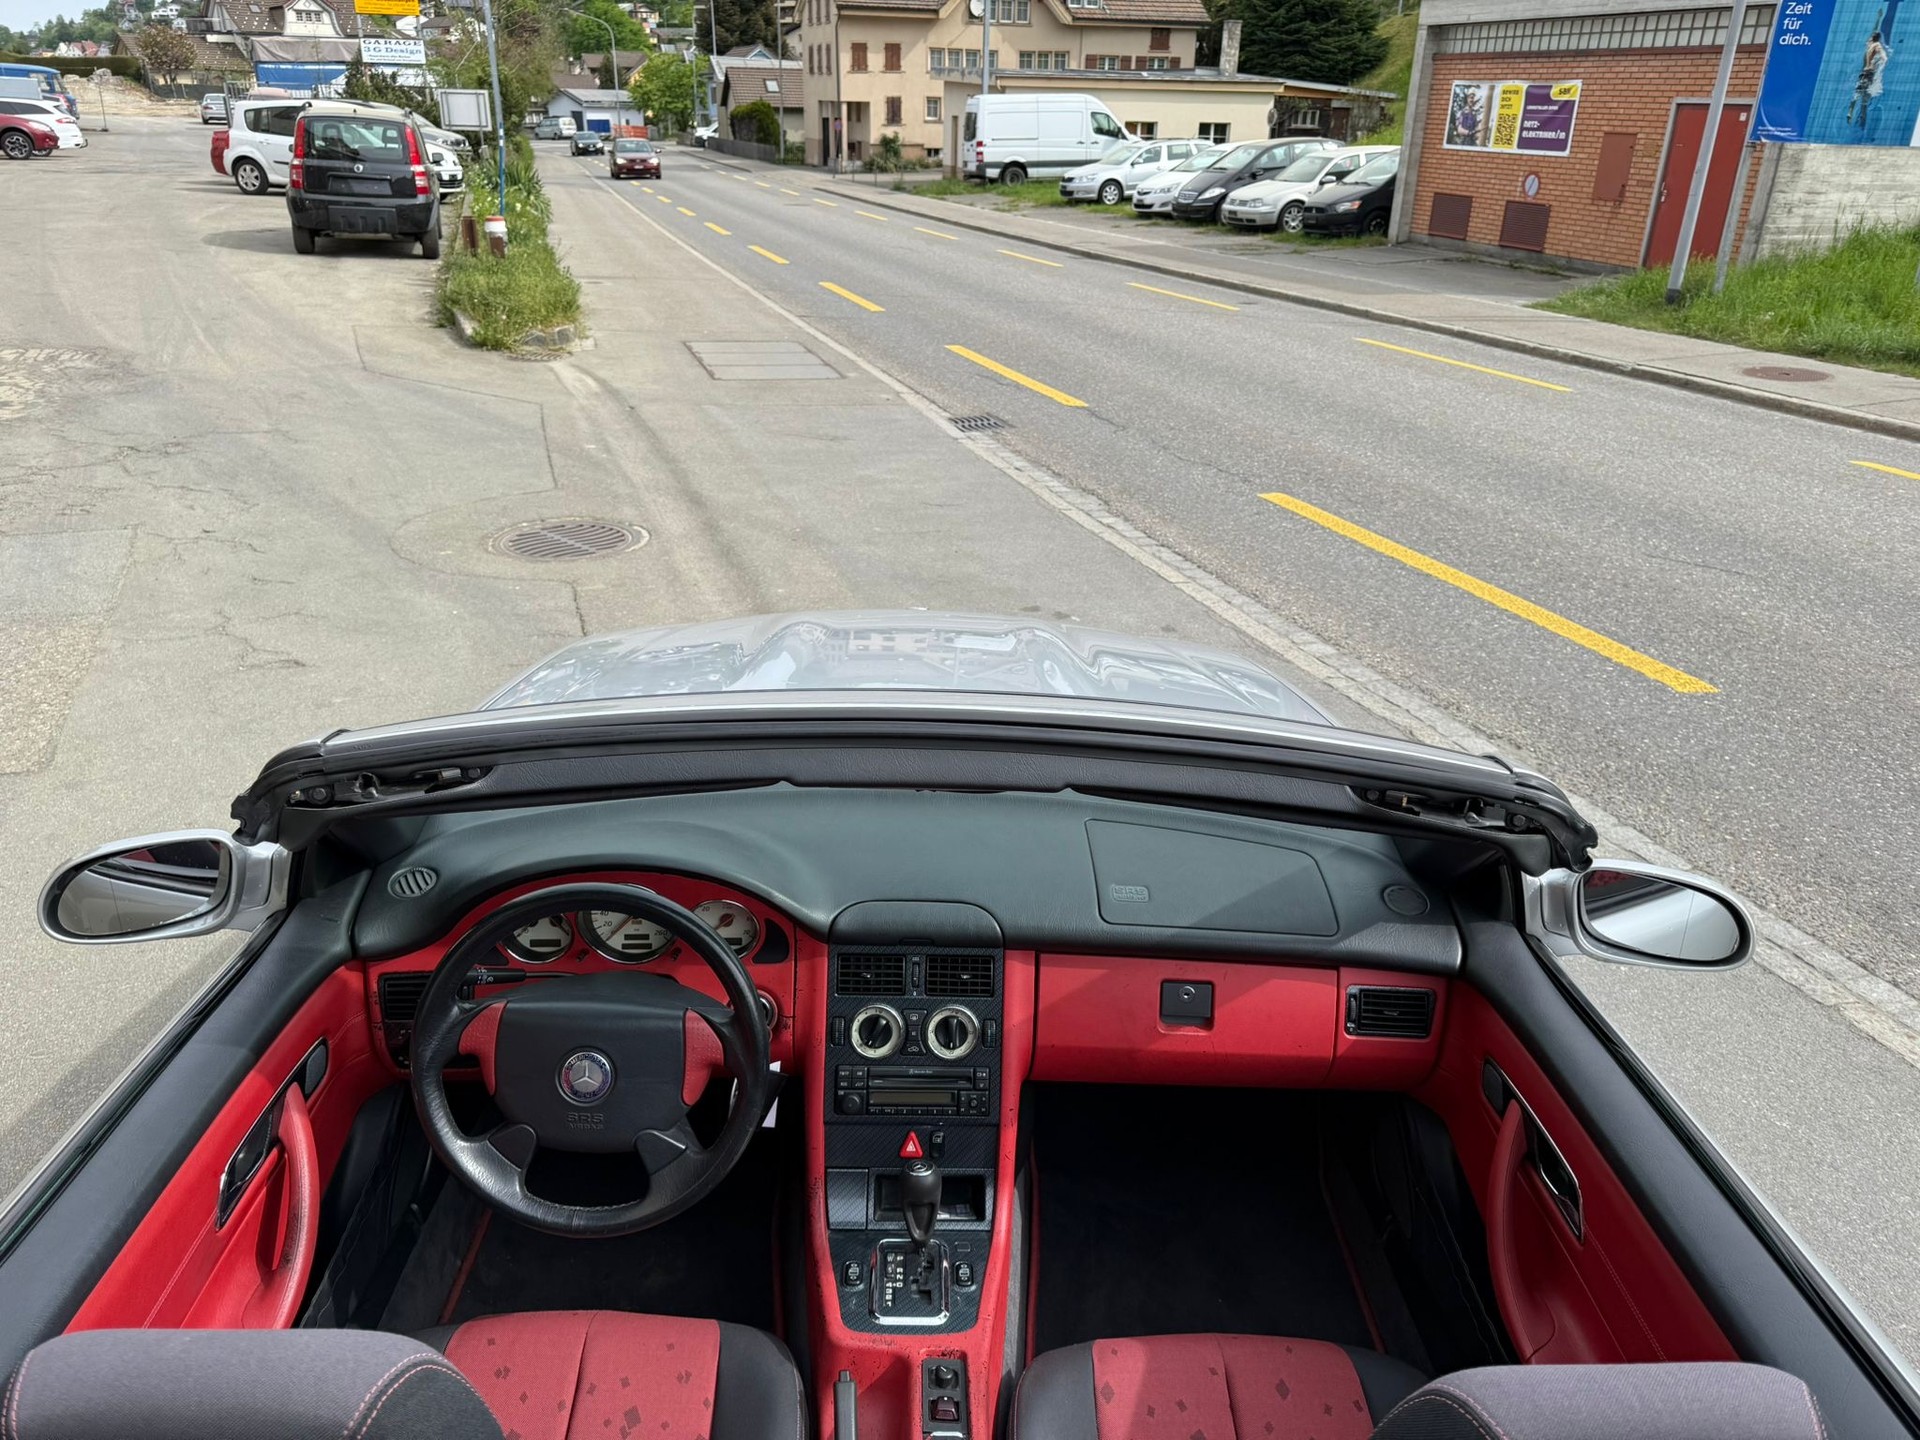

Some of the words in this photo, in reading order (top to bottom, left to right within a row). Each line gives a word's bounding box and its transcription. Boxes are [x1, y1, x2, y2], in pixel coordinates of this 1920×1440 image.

[1785, 2, 1813, 15] Zeit
[1783, 18, 1803, 30] für
[362, 39, 422, 47] GARAGE
[1779, 33, 1812, 46] dich.
[385, 47, 422, 55] Design
[567, 1112, 604, 1123] SRS
